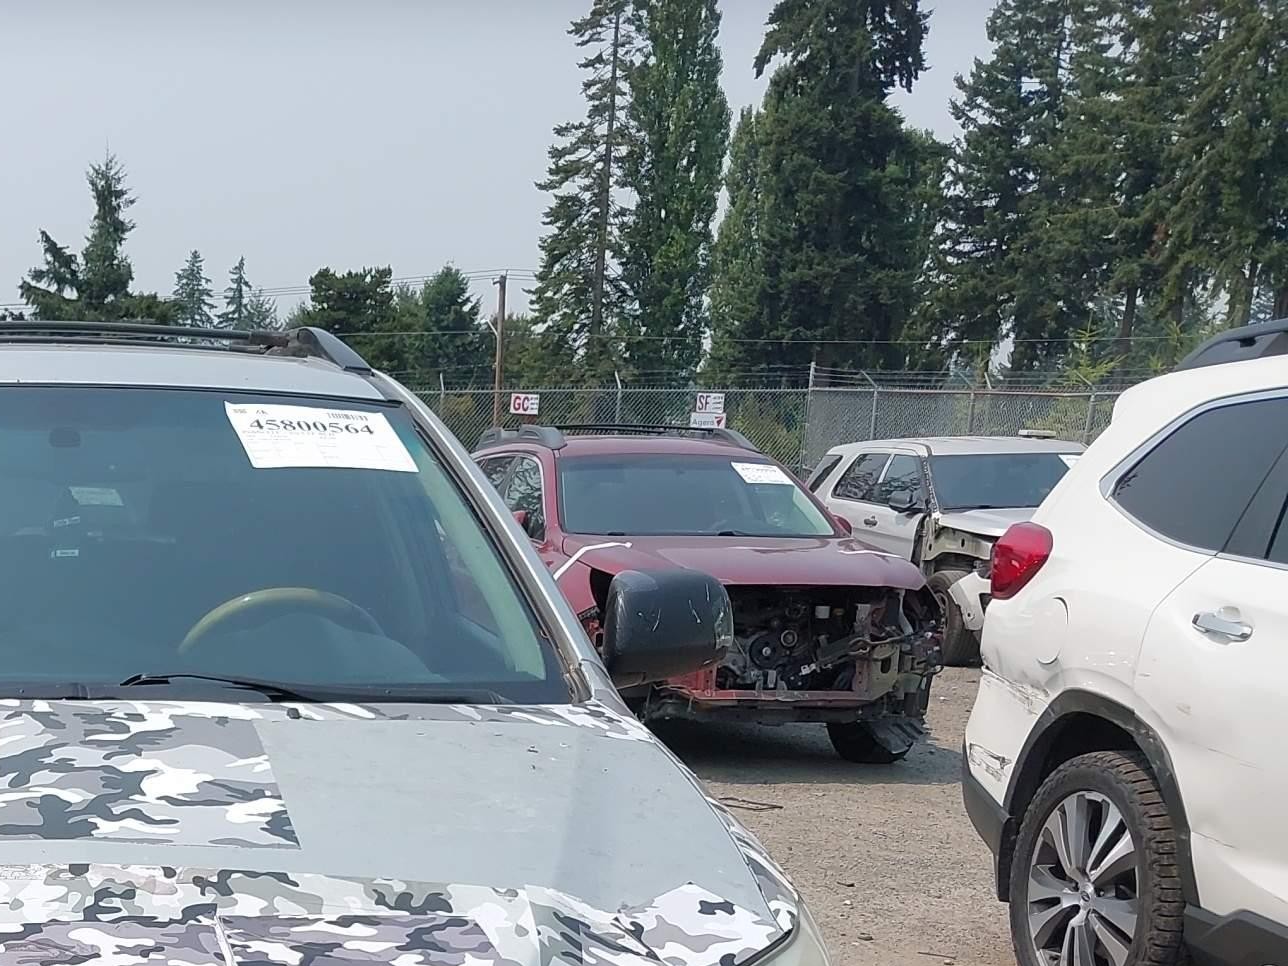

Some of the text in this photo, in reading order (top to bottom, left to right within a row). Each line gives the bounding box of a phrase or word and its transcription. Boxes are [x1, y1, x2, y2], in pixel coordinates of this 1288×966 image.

[512, 395, 530, 412] GC
[697, 394, 712, 411] SF
[249, 418, 375, 436] 45800564
